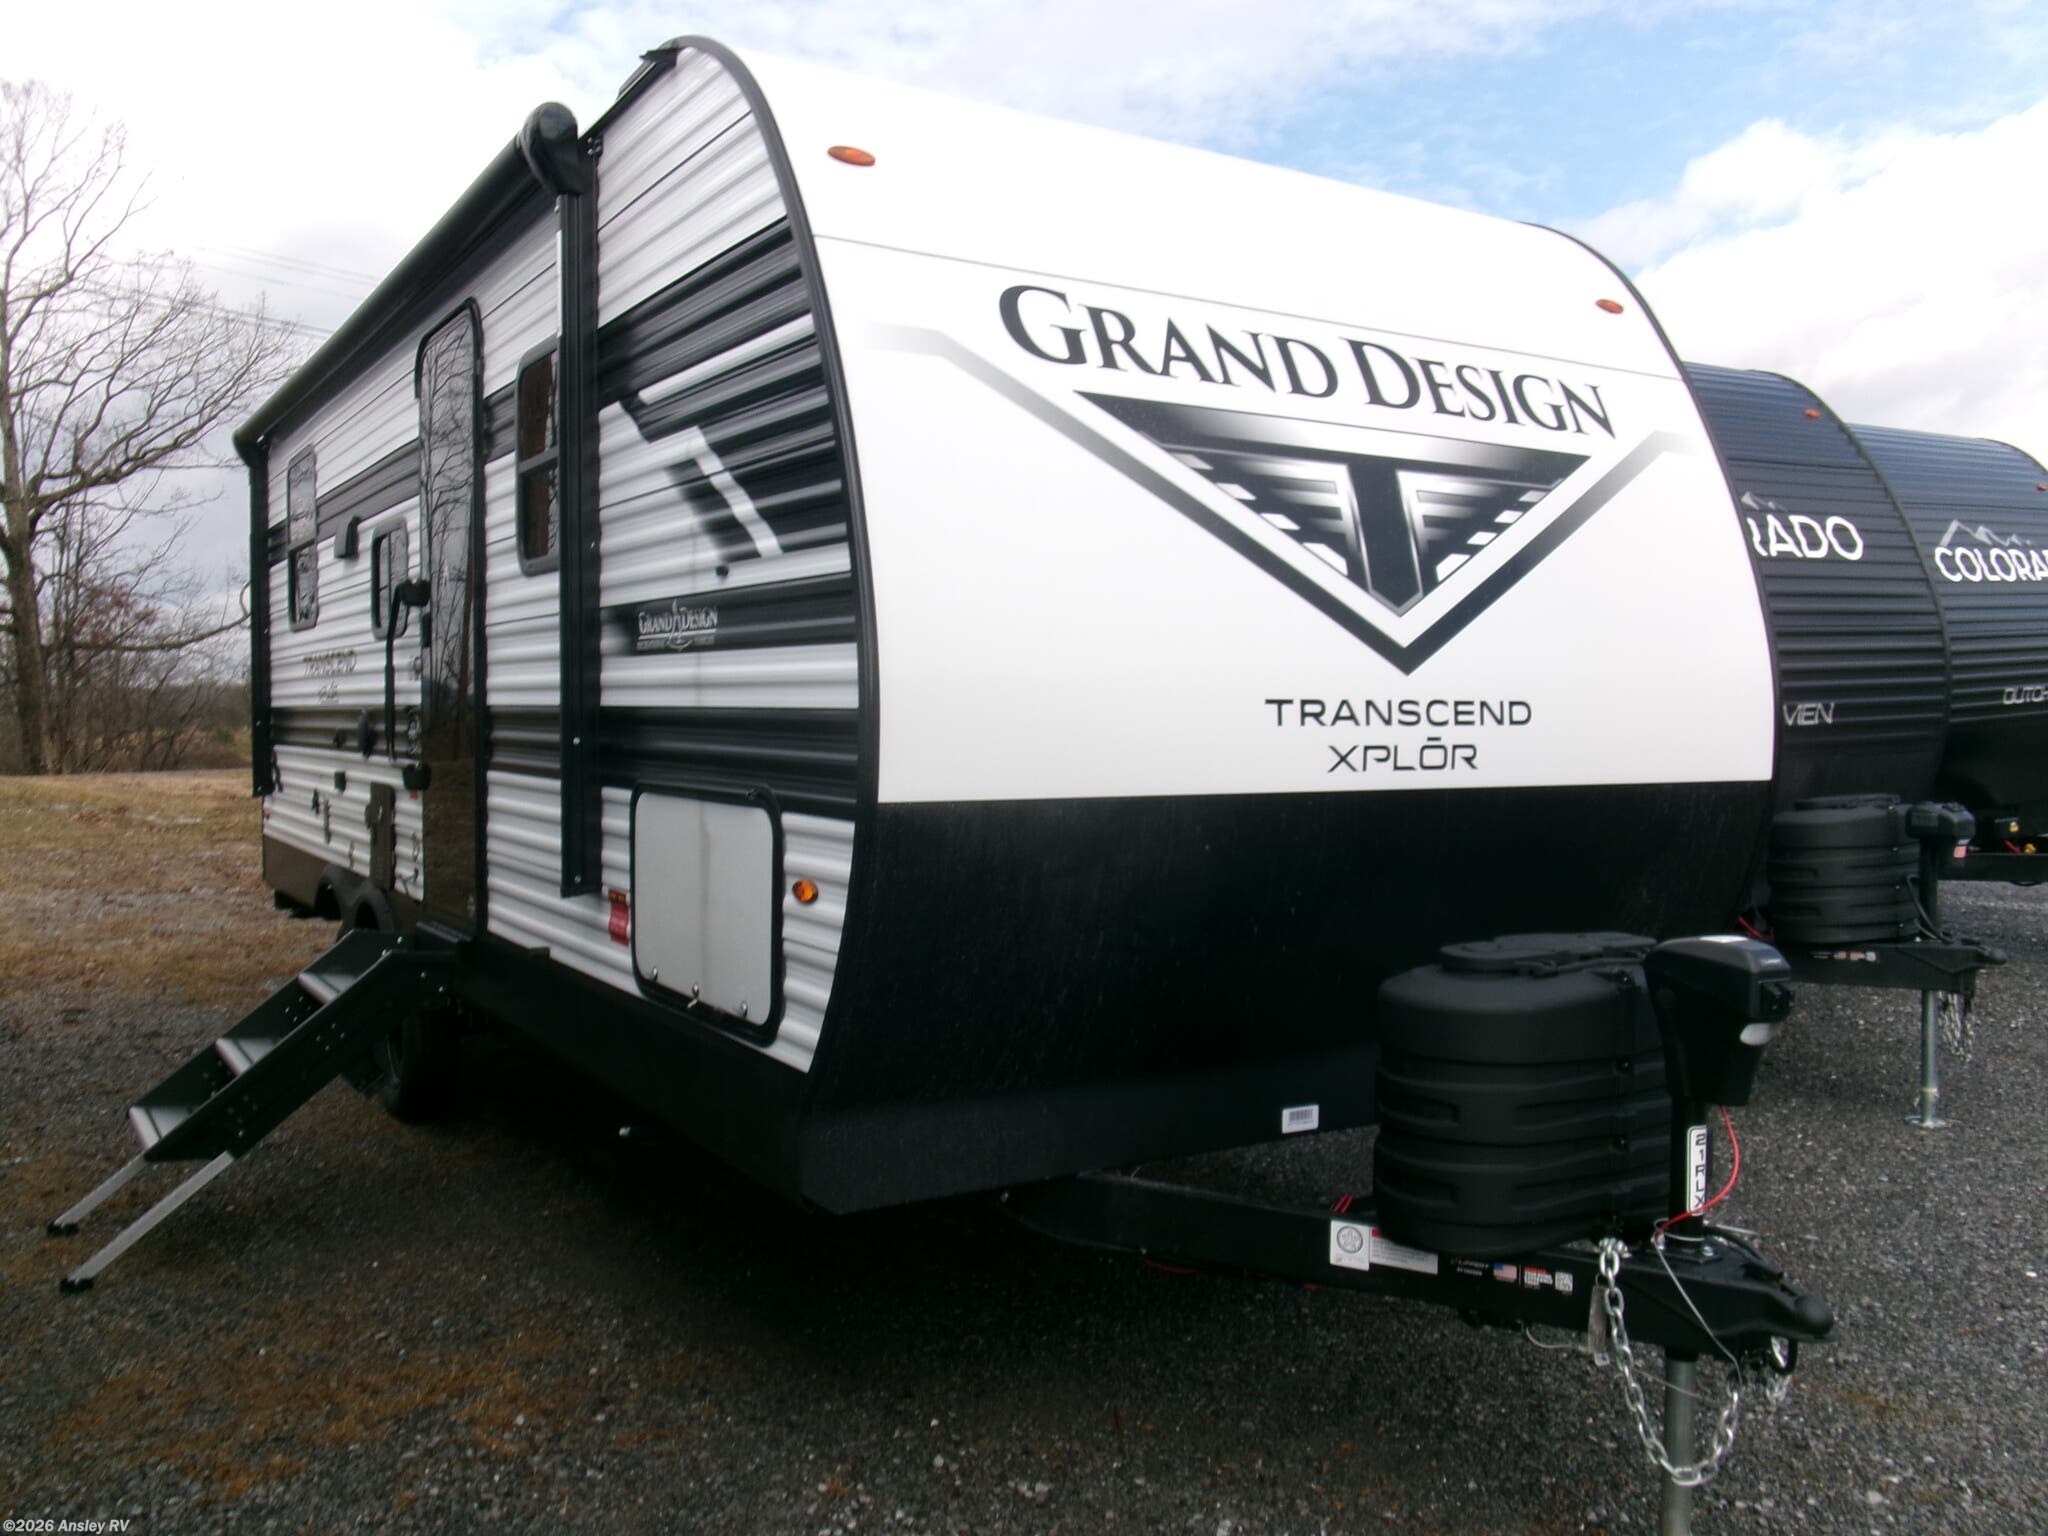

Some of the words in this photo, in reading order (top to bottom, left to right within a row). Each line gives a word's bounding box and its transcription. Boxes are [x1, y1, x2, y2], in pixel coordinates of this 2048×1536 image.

[1000, 284, 1339, 399] GRAND
[1339, 336, 1616, 440] DESIGN
[1935, 546, 2048, 582] COLORA
[1265, 698, 1532, 727] TRANSCEND
